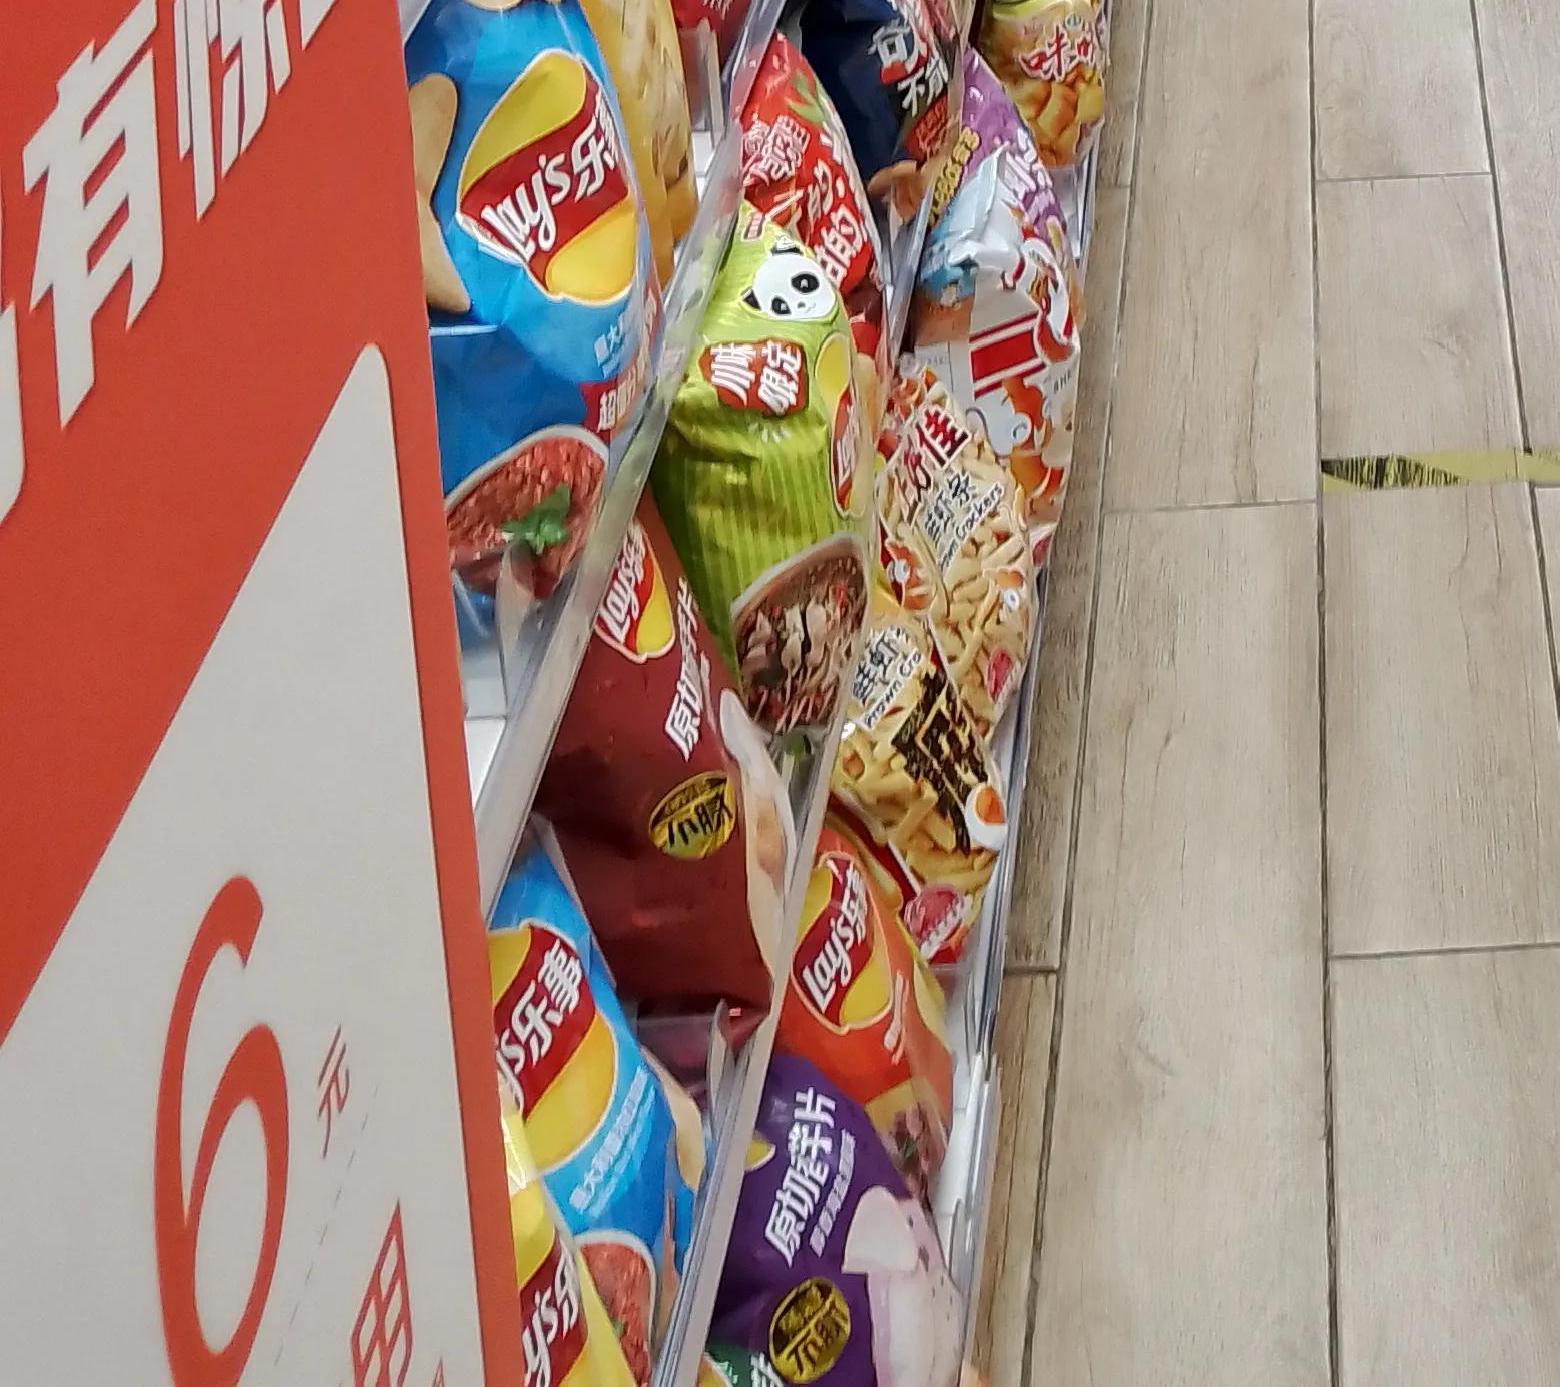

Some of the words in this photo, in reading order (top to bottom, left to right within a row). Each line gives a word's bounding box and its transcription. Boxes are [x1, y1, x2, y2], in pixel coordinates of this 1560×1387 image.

[481, 147, 573, 265] Lay's
[756, 337, 803, 416] 限定
[510, 940, 587, 1058] 乐事
[801, 912, 853, 1015] Lay's
[155, 875, 289, 1387] 6
